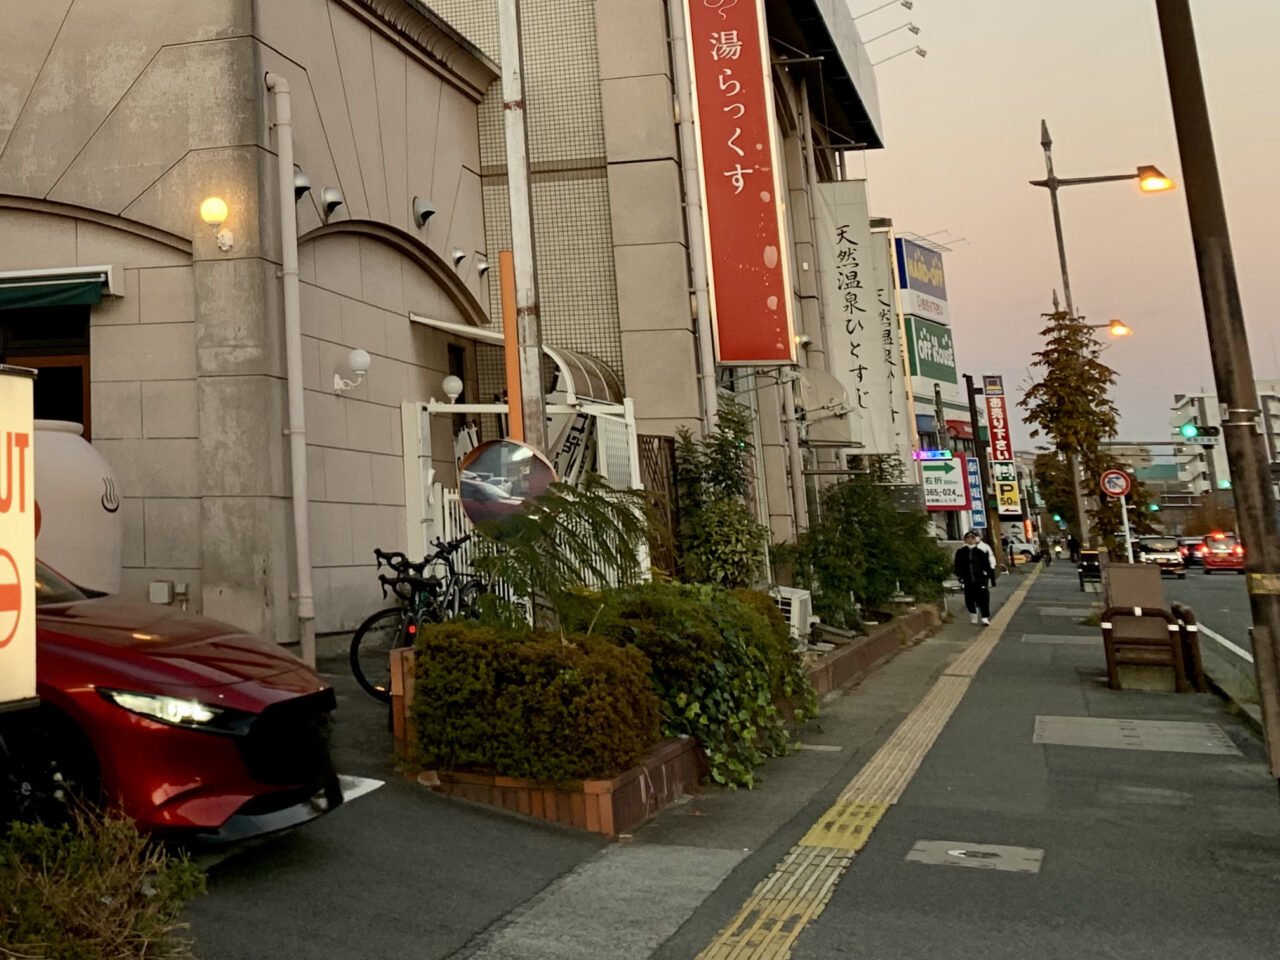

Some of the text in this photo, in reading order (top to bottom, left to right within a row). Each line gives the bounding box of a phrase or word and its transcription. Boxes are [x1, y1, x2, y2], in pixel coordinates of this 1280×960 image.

[710, 30, 754, 195] 湯らっくす
[835, 225, 868, 409] 天然温泉ひとすじ
[919, 340, 955, 368] OFF HOUSE
[990, 398, 1010, 460] お売り下さい
[999, 484, 1014, 496] P
